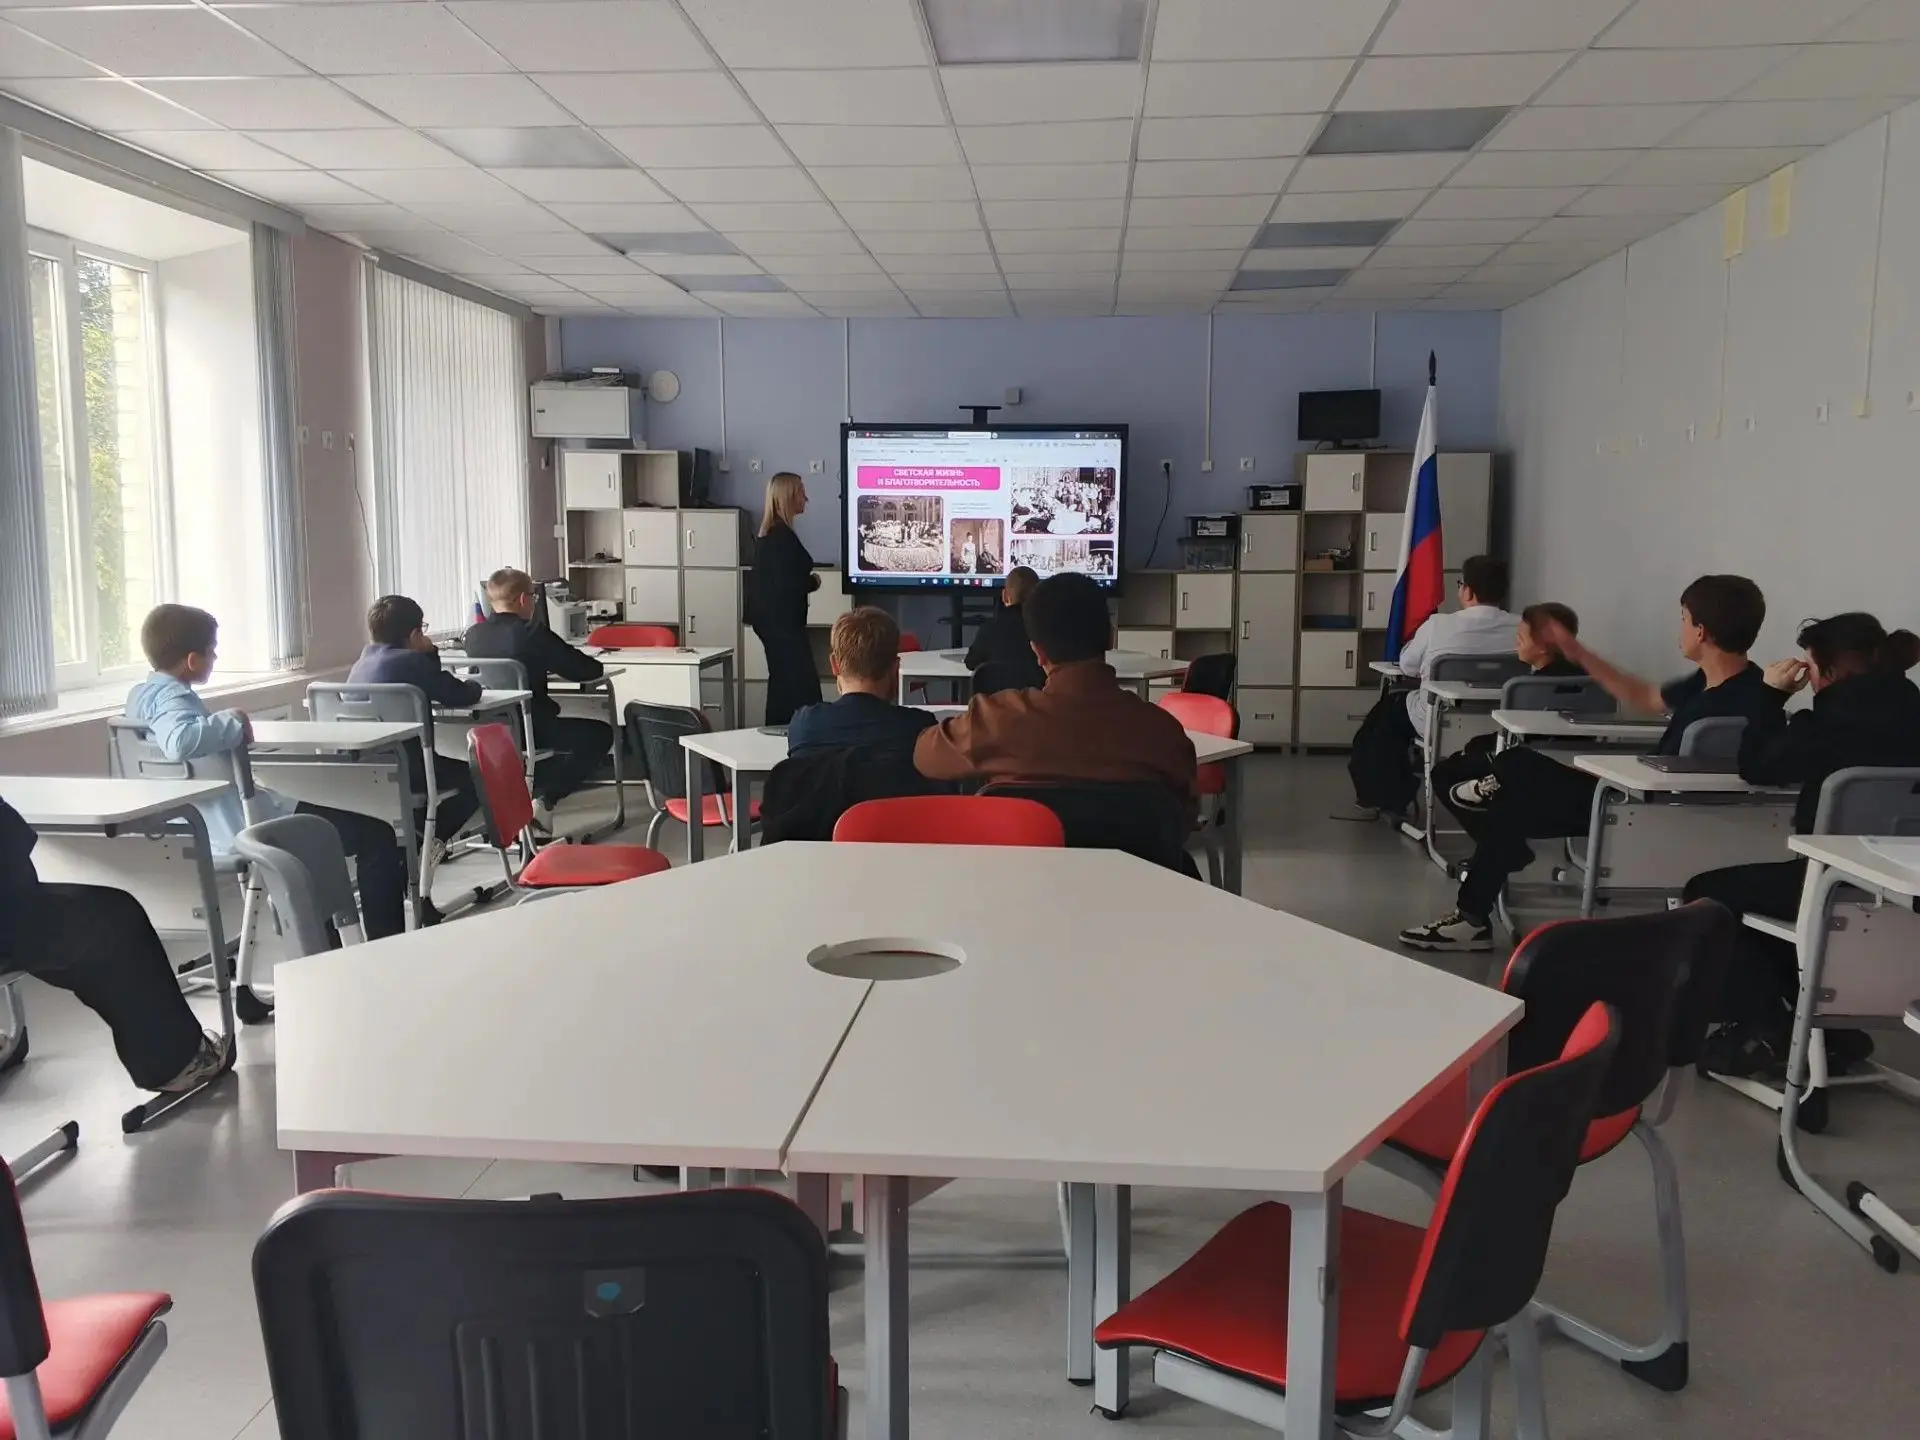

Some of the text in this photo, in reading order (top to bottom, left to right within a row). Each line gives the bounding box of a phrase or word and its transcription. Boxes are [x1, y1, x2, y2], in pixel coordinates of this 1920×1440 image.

[893, 468, 964, 477] СВЕТСКАЯ ЖИЗНЬ
[877, 478, 981, 487] И БЛАГОТВОРИТЕЛЬНОСТЬ
